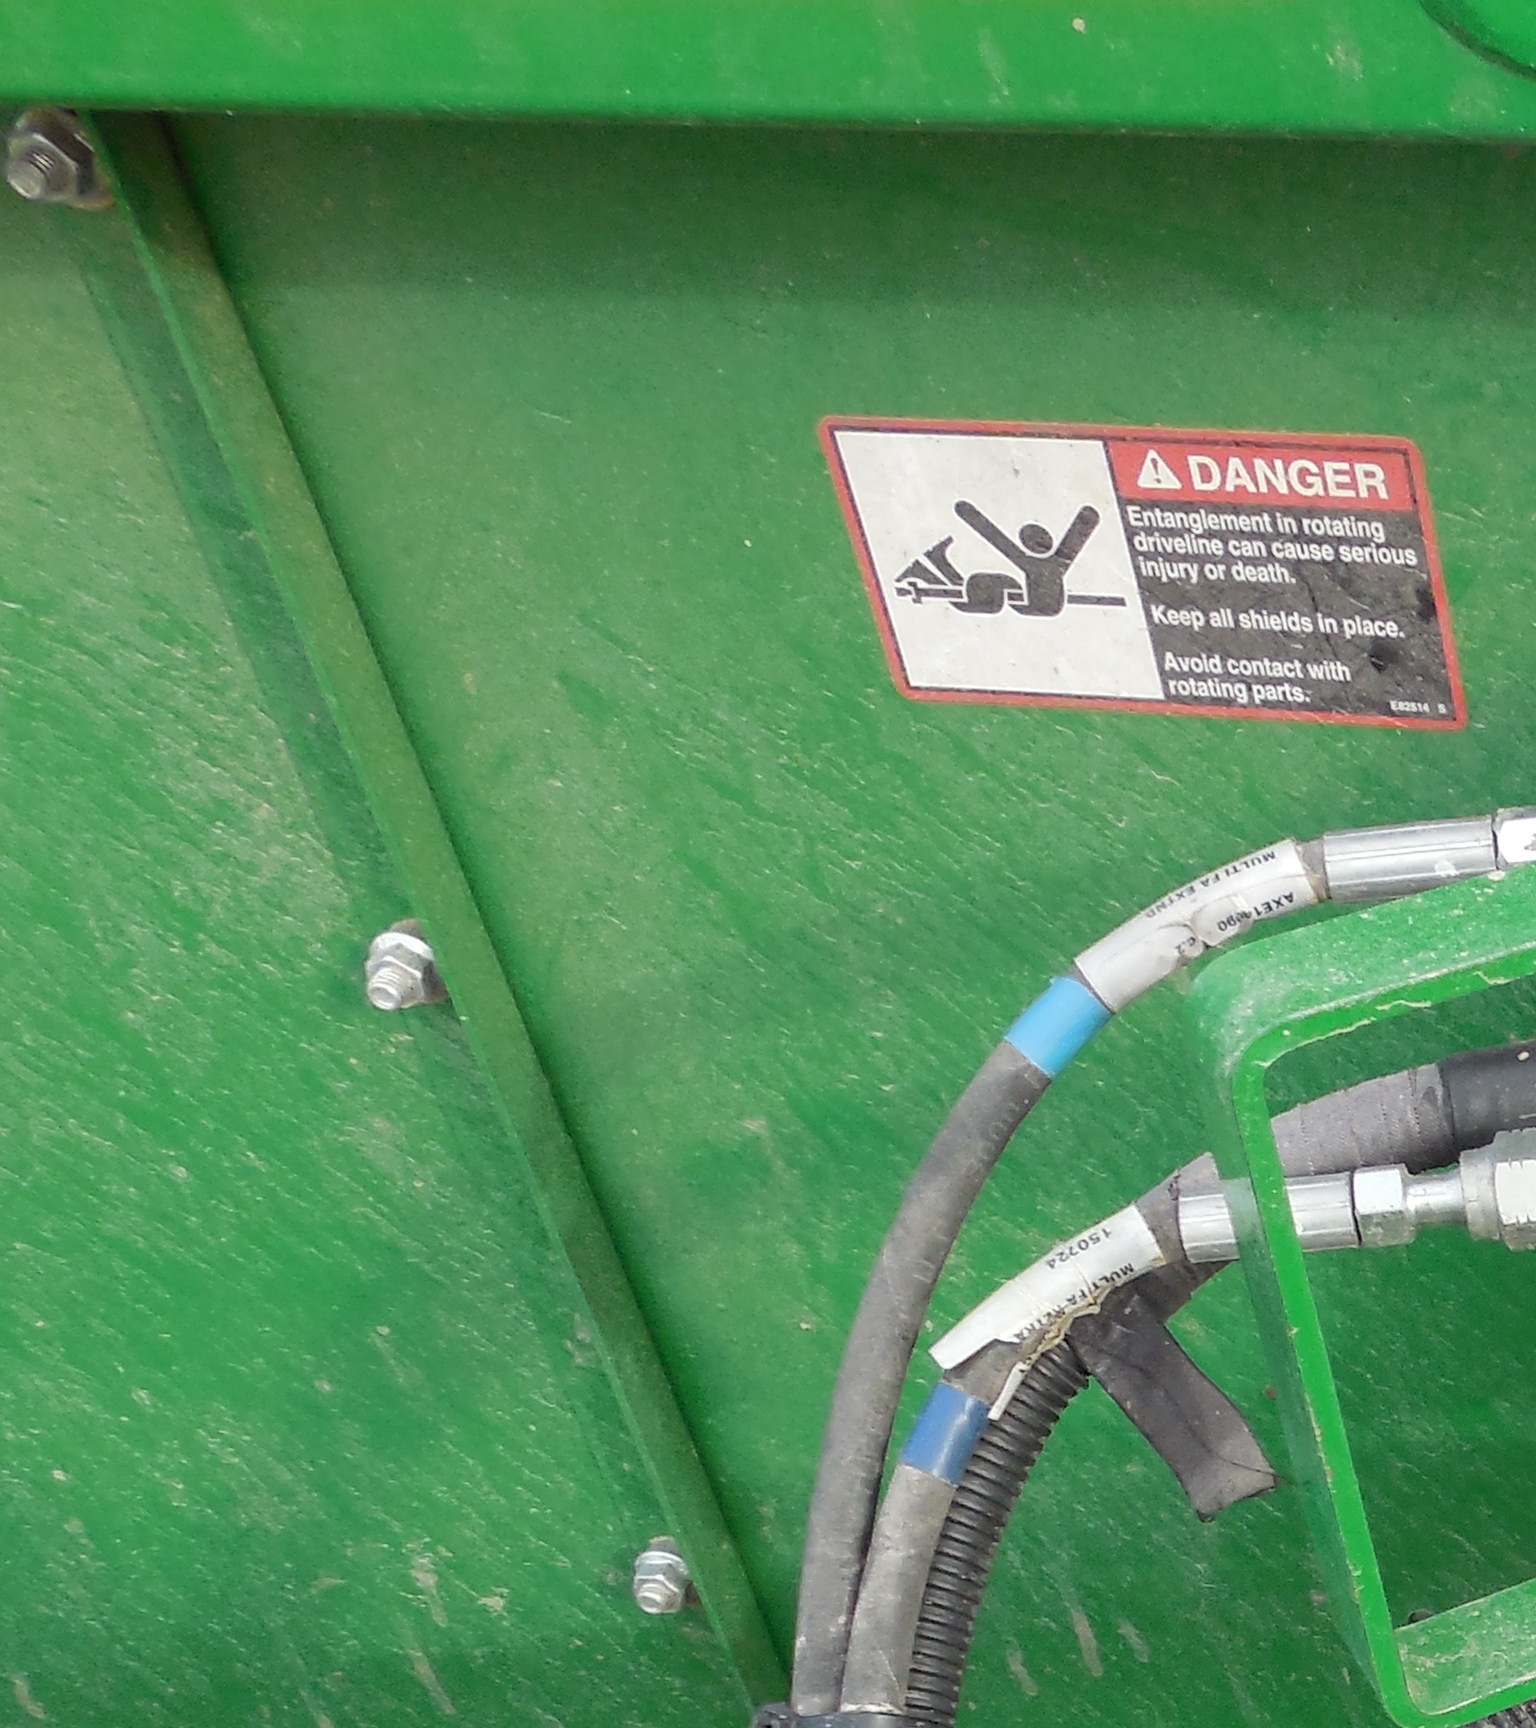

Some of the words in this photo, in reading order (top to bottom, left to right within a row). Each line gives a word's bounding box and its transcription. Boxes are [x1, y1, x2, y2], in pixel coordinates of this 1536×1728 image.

[1187, 455, 1390, 500] DANGER
[1126, 505, 1272, 535] Entanglement
[1275, 513, 1298, 534] in
[1302, 515, 1384, 543] rotating
[1133, 532, 1223, 556] driveline
[1228, 541, 1268, 558] can
[1271, 543, 1334, 562] cause
[1340, 544, 1418, 567] serious
[1140, 558, 1198, 584] injury
[1205, 563, 1226, 581] or
[1231, 561, 1296, 584] death.
[1150, 604, 1205, 631] Keep
[1209, 608, 1234, 629] all
[1238, 609, 1313, 633] shields
[1317, 613, 1340, 634] in
[1343, 615, 1406, 639] place.
[1164, 651, 1222, 675] Avoid
[1226, 657, 1302, 680] contact
[1306, 660, 1351, 682] with
[1168, 679, 1249, 702] rotating
[1253, 684, 1311, 704] parts.
[1200, 873, 1221, 888] FA
[1225, 851, 1277, 877] MULTI
[1046, 1228, 1112, 1269] 150724
